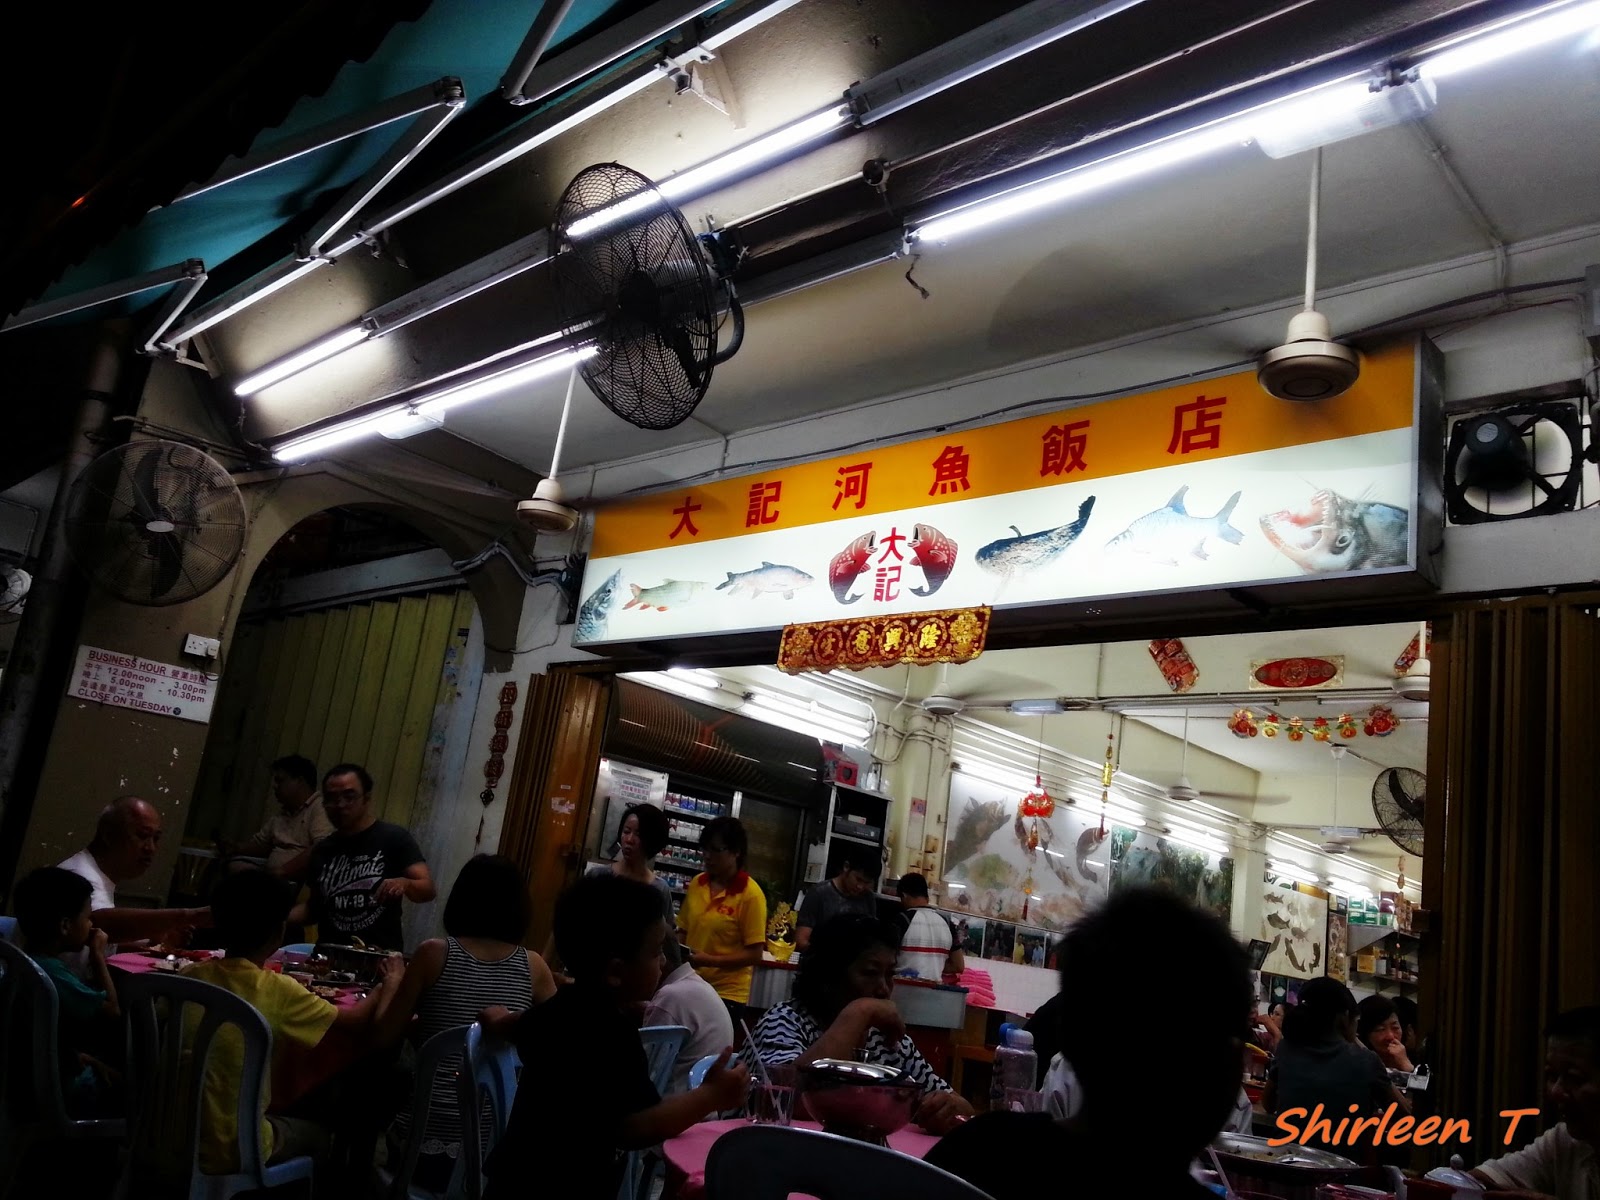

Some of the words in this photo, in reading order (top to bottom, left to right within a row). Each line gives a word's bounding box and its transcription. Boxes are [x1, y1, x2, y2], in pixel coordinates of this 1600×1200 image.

[669, 394, 1228, 540] 大記河魚飯店
[874, 527, 906, 602] 大記
[89, 650, 137, 669] BUSINESS
[139, 662, 166, 675] HOUR
[108, 667, 156, 684] 12.00noon
[174, 681, 207, 695] 3.00pm
[110, 676, 145, 690] 5.00pm
[167, 688, 205, 703] 10.30pm
[78, 688, 110, 701] CLOSE
[113, 695, 127, 705] ON
[130, 698, 172, 713] TUESDAY
[335, 894, 365, 909] NY-19
